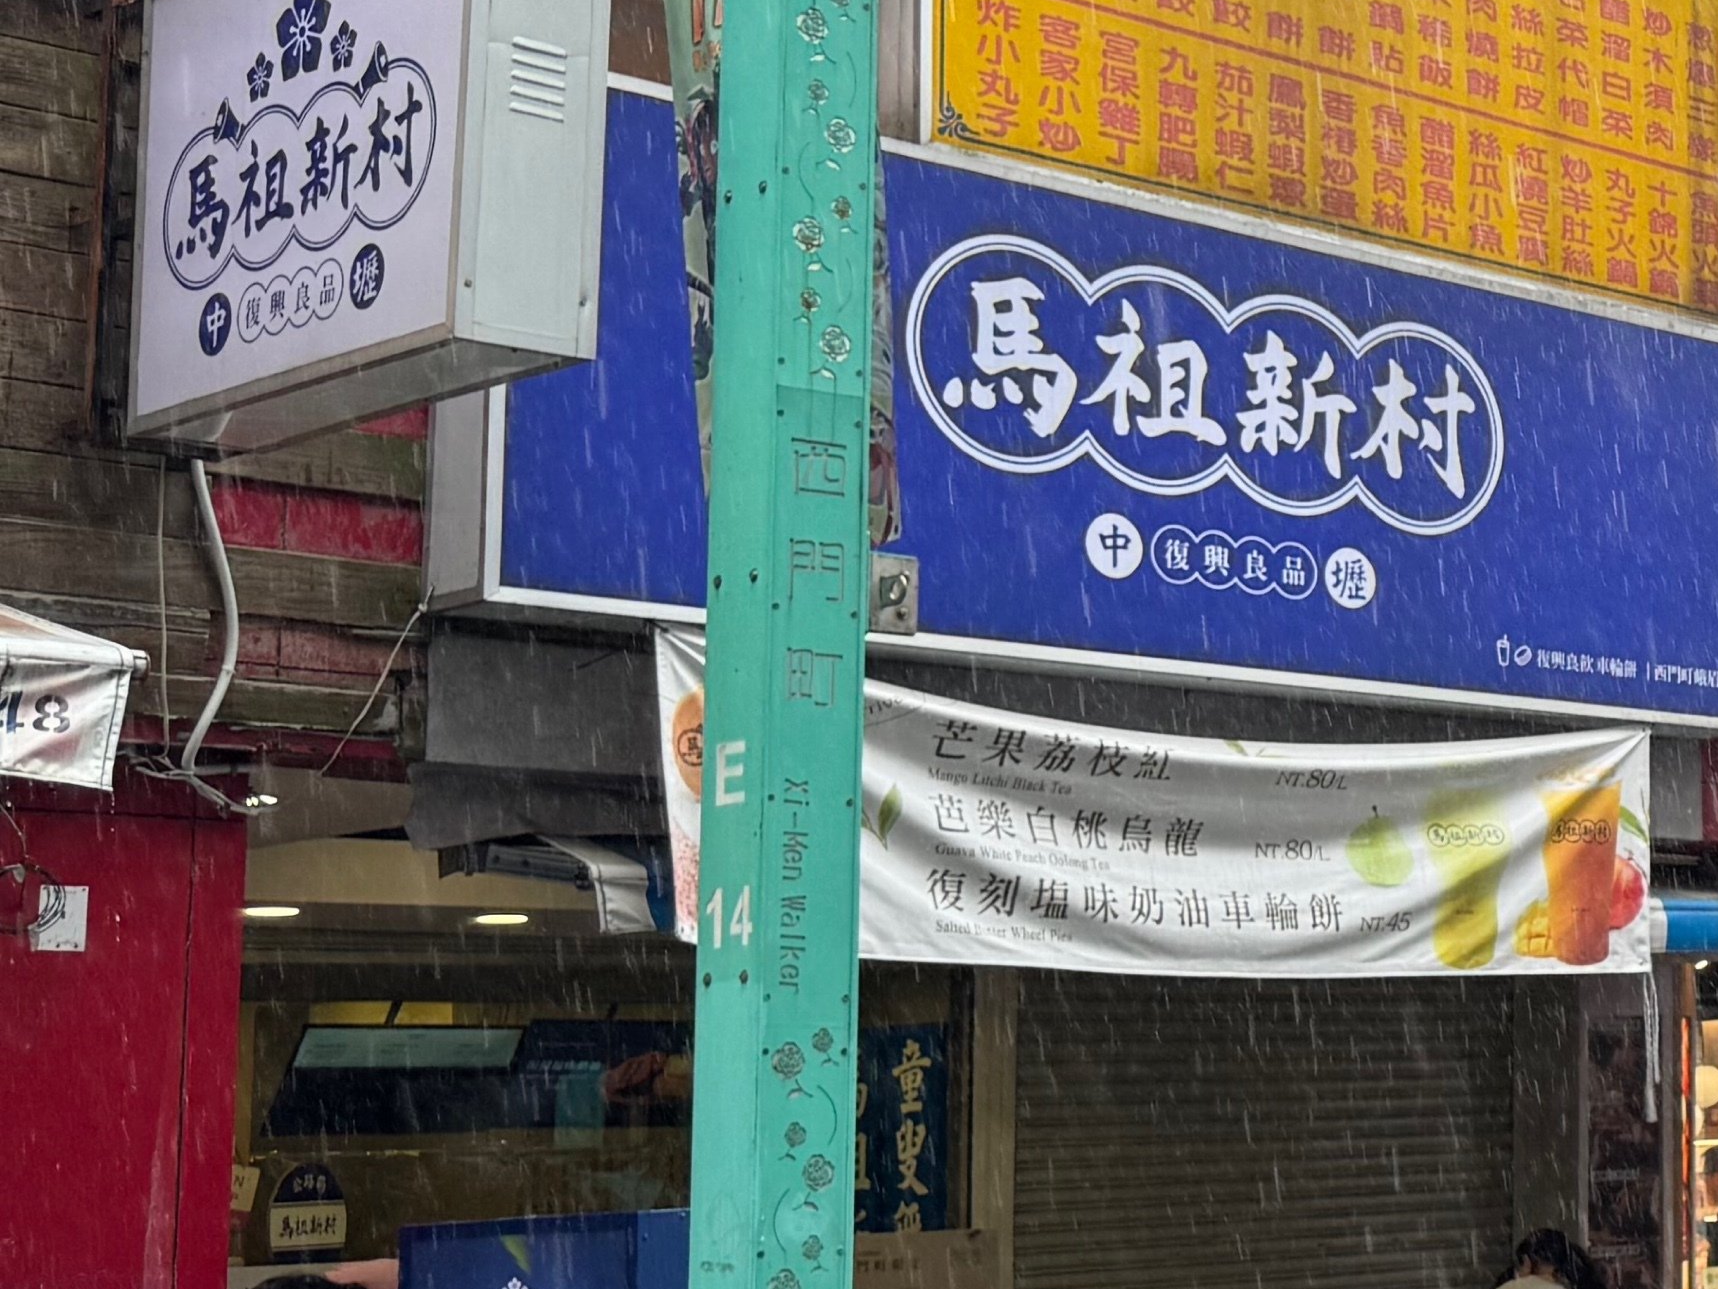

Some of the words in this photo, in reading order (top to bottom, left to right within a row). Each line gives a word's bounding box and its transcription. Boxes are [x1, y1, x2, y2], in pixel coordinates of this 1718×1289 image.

[1038, 12, 1082, 154] 客家小炒
[175, 81, 424, 261] 馬祖新村
[244, 272, 336, 329] 復興良品
[942, 278, 1476, 497] 馬祖新村
[786, 436, 848, 709] 西門町
[1164, 539, 1305, 587] 復興良品
[715, 740, 746, 807] E
[927, 766, 968, 784] Mango
[1012, 776, 1046, 794] Black
[1051, 780, 1072, 795] Tea
[932, 719, 1175, 782] 芒果荔枝紅
[782, 777, 810, 882] Xi-Men
[928, 793, 1204, 857] 芭樂白桃烏龍
[935, 842, 976, 859] Guava
[979, 845, 1013, 862] White
[1015, 848, 1047, 866] Peach
[1090, 856, 1110, 872] Tea
[705, 885, 753, 950] 14
[926, 868, 1343, 934] 復刻塩味奶油車輪餅
[779, 892, 808, 995] Walker
